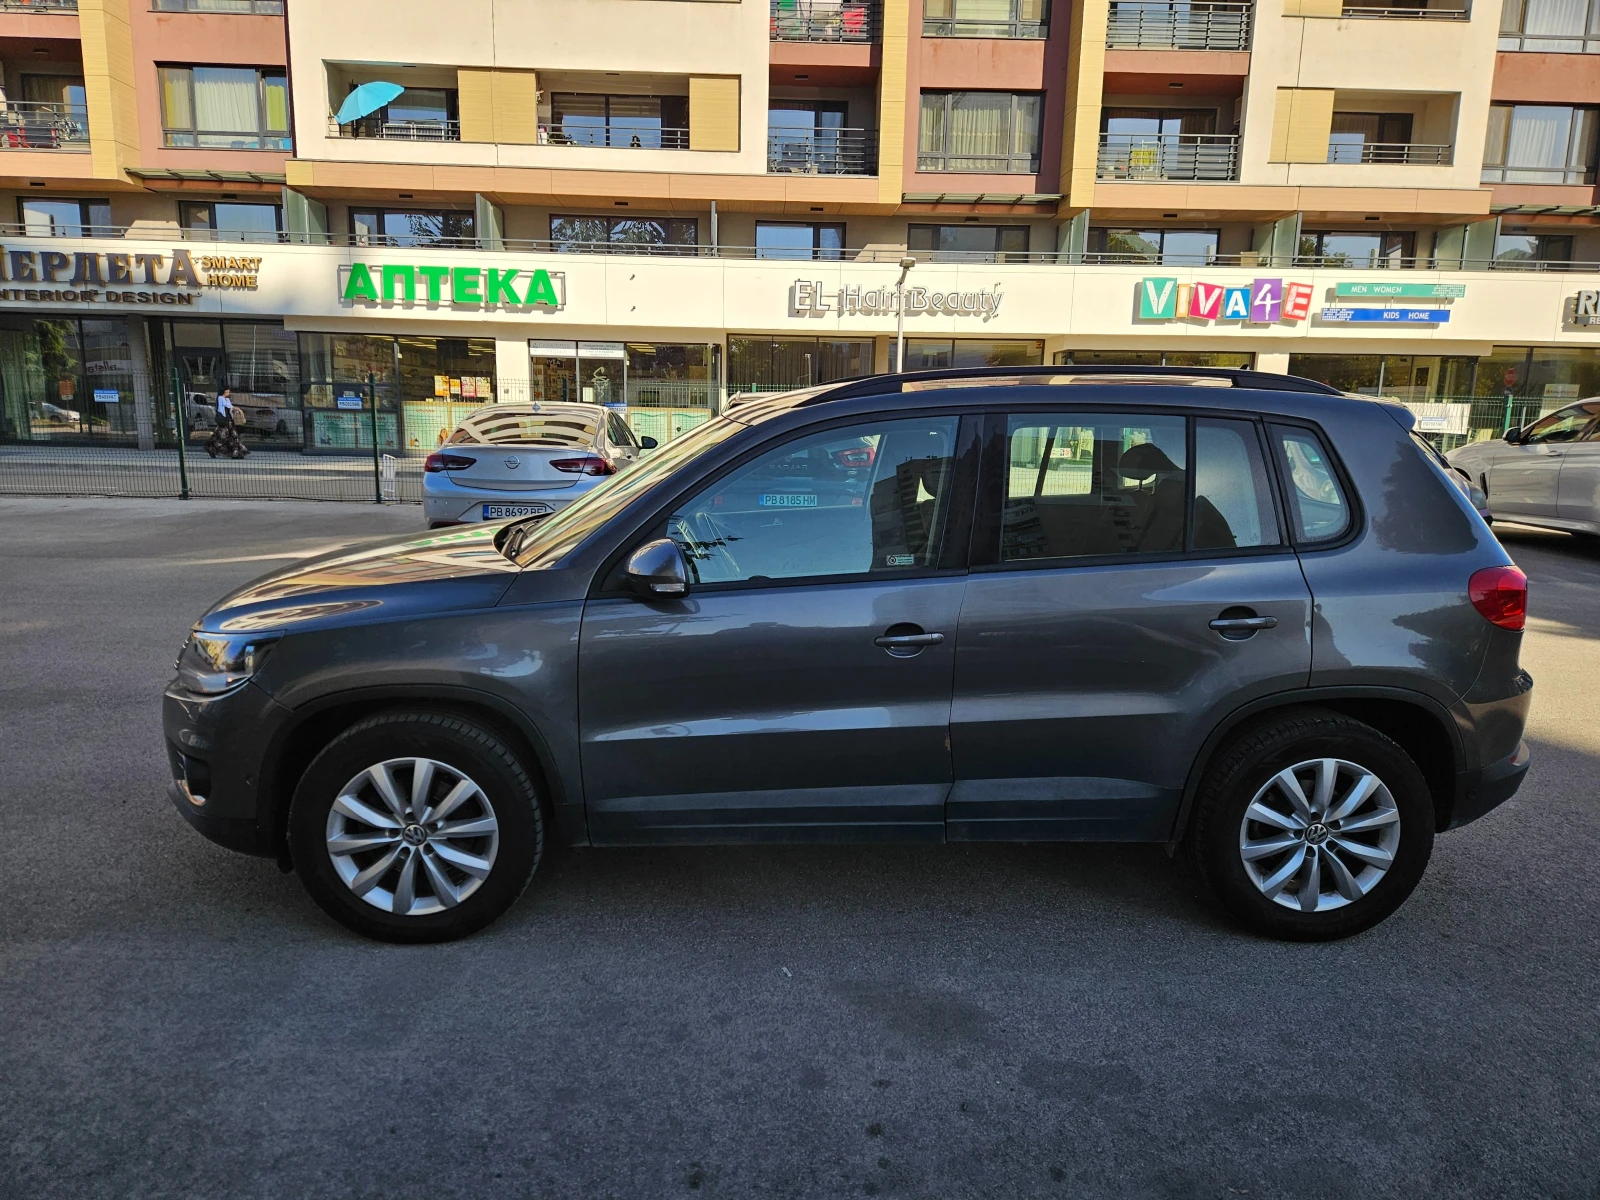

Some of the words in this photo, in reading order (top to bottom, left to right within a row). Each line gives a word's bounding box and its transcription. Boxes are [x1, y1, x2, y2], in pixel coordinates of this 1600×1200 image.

[0, 245, 202, 288] ЕРДЕТА
[201, 255, 262, 271] SMART
[206, 274, 258, 289] HOME
[344, 262, 559, 306] АПТЕКА
[1351, 285, 1368, 293] MEN
[1373, 286, 1402, 294] WOMEN
[106, 290, 194, 306] DESIGN
[794, 280, 831, 311] EL
[843, 284, 899, 312] Hair
[910, 286, 1004, 316] Beauty
[1144, 279, 1310, 322] VIVA4E
[1383, 311, 1400, 320] KIDS
[1408, 312, 1430, 320] HOME
[765, 496, 777, 505] PB
[779, 496, 801, 505] 8185
[803, 496, 816, 506] HM
[490, 507, 503, 517] PB
[505, 507, 529, 517] 8692
